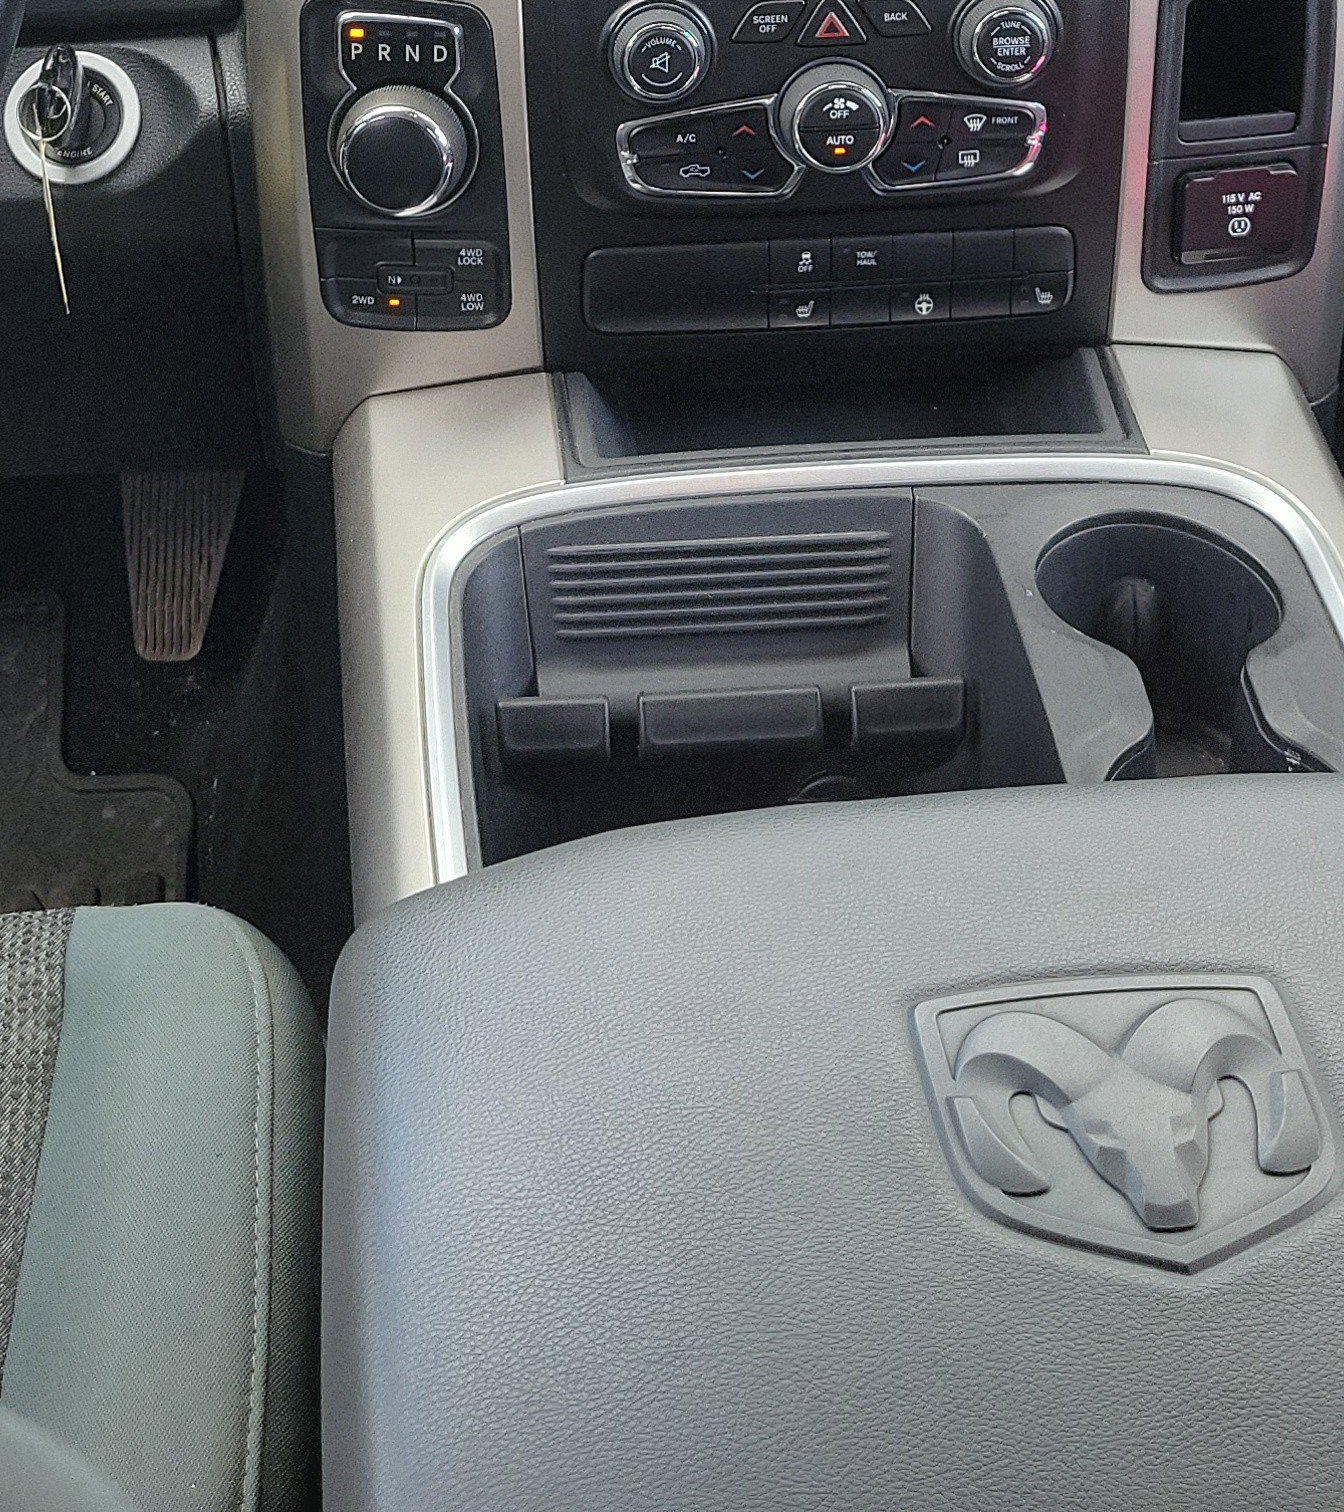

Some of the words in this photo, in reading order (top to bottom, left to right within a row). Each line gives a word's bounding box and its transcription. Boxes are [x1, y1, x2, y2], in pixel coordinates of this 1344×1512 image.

[753, 15, 788, 23] SCREEN
[884, 12, 908, 21] BACK
[759, 25, 777, 33] OFF
[1000, 21, 1022, 29] TUNE
[645, 37, 677, 48] VOLUME
[992, 36, 1030, 45] BROWSE
[351, 44, 363, 60] P
[378, 45, 391, 61] R
[405, 45, 420, 62] N
[433, 45, 448, 62] D
[997, 47, 1026, 56] ENTER
[996, 62, 1024, 71] SCROLL
[92, 84, 113, 106] START
[829, 110, 850, 119] OFF
[676, 132, 697, 144] A/C
[826, 136, 854, 146] AUTO
[1222, 194, 1236, 203] 115
[1238, 193, 1244, 202] V
[1249, 192, 1262, 201] AC
[1227, 205, 1243, 214] 150
[1244, 204, 1254, 213] W
[459, 248, 483, 258] 4WD
[458, 256, 484, 265] LOCK
[857, 258, 877, 266] HAUL
[797, 265, 814, 273] OFF
[387, 276, 397, 285] N
[352, 295, 375, 305] 2WD
[460, 293, 484, 302] 4WD
[461, 301, 484, 311] LOW
